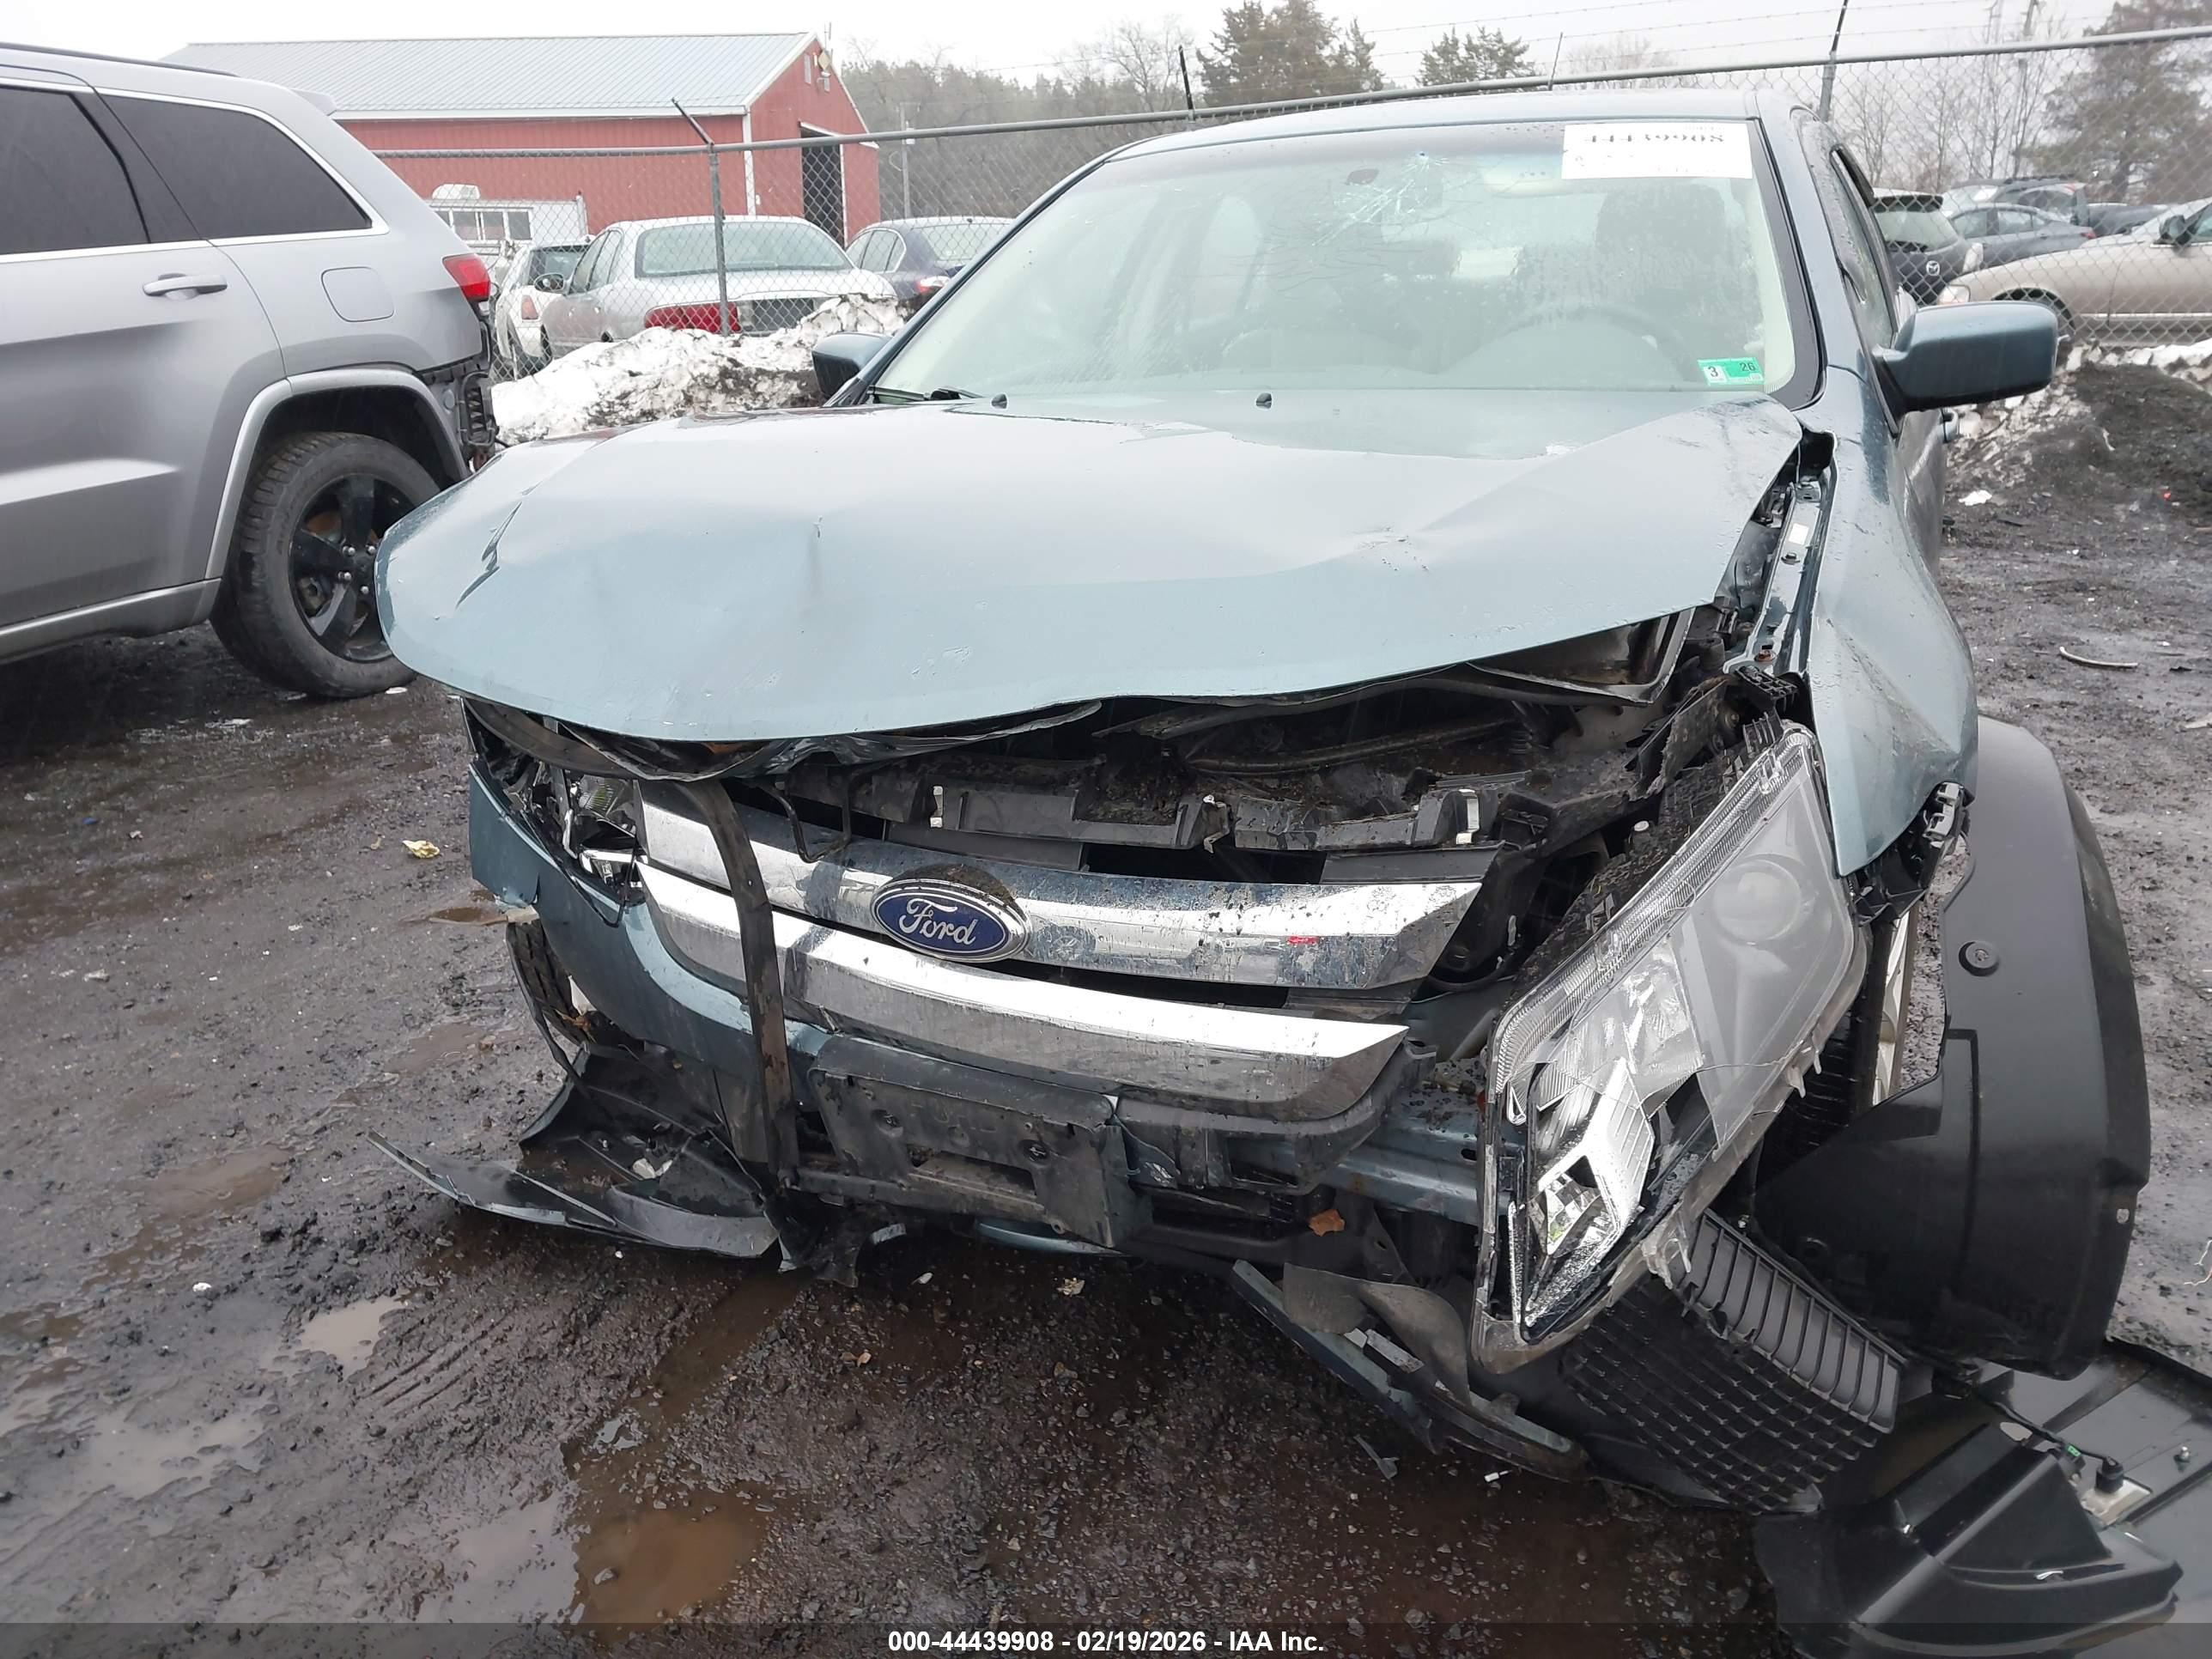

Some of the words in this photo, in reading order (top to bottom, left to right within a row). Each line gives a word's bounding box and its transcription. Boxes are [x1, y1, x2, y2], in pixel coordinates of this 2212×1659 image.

[1708, 366, 1718, 378] 3
[1739, 362, 1756, 372] 26
[899, 898, 978, 945] Ford
